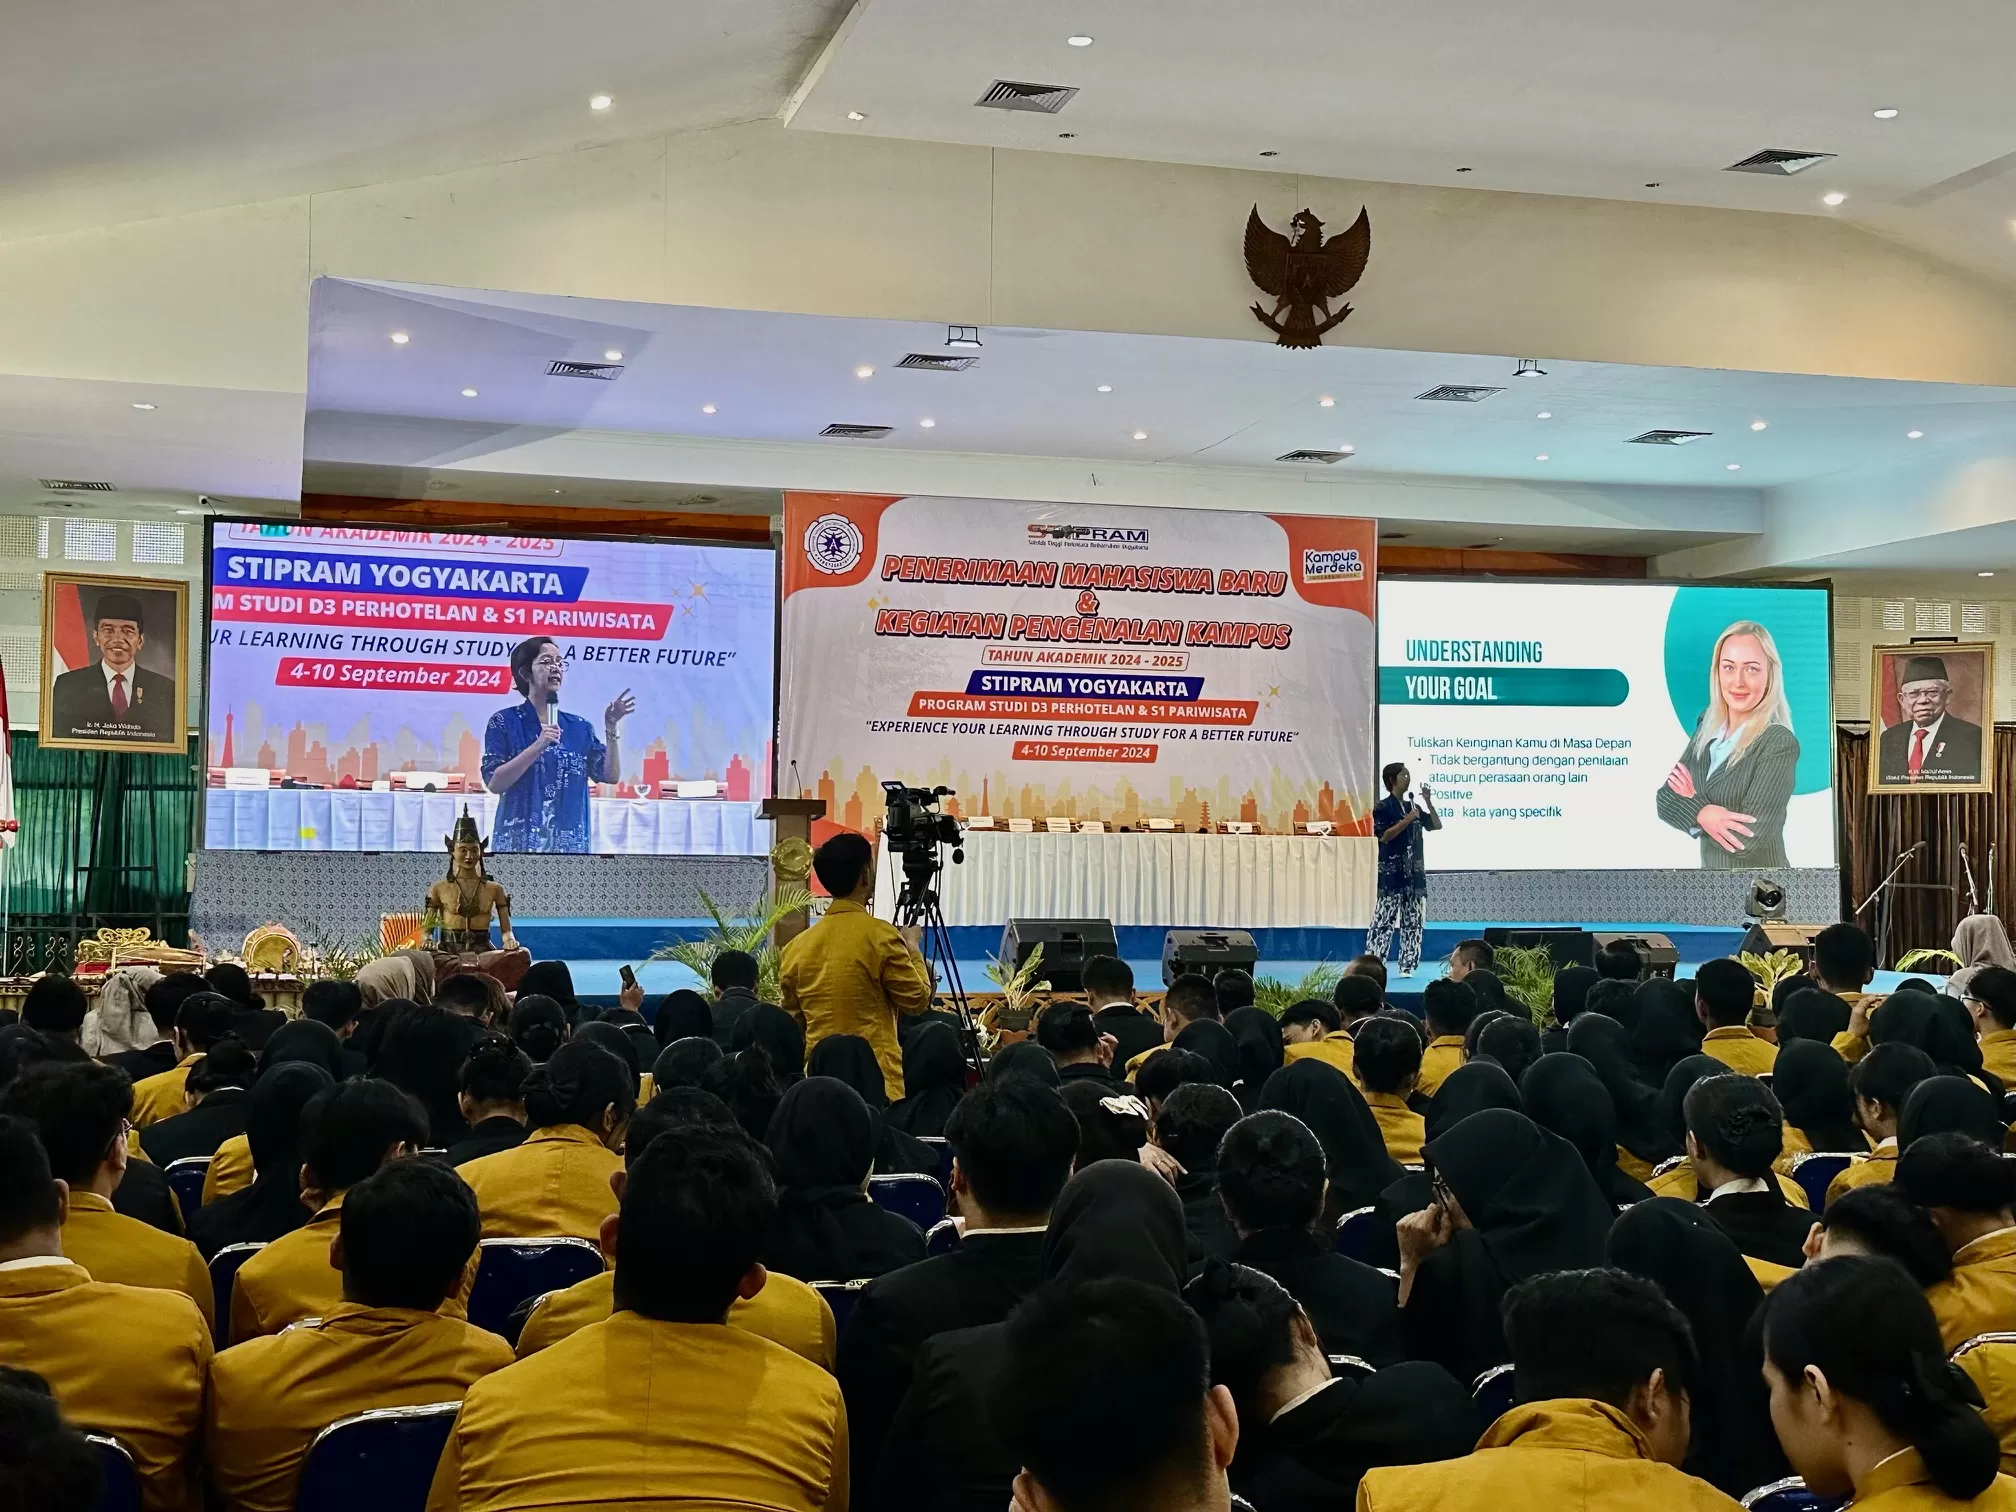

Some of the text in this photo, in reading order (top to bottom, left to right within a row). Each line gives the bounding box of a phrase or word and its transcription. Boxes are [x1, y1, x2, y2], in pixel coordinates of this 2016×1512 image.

[1305, 551, 1357, 564] Kampus
[1305, 561, 1362, 574] Merdeka
[227, 555, 564, 596] STIPRAM YOGYAKARTA
[882, 555, 1057, 587] PENERIMAAN
[1060, 562, 1213, 594] MAHASISWA
[1217, 570, 1288, 597] BARU
[240, 594, 303, 614] STUDI
[309, 598, 337, 616] D3
[342, 600, 477, 623] PERHOTELAN
[482, 606, 499, 622] &
[503, 607, 526, 624] S1
[532, 608, 656, 630] PARIWISATA
[1075, 590, 1100, 616] &
[875, 609, 1292, 650] KEGIATAN PENGENALAN KAMPUS
[238, 629, 344, 651] LEARNING
[350, 634, 449, 655] THROUGH
[453, 639, 516, 658] STUDY
[564, 644, 576, 660] A
[583, 646, 650, 664] BETTER
[1406, 639, 1543, 663] UNDERSTANDING
[988, 650, 1033, 663] TAHUN
[1036, 651, 1107, 665] AKADEMIK
[1109, 653, 1141, 666] 2024
[1152, 655, 1184, 667] 2025
[290, 661, 501, 688] 4-10 September 2024
[981, 675, 1189, 697] STIPRAM YOGYAKARTA
[1405, 675, 1498, 700] YOUR GOAL
[919, 698, 1248, 720] PROGRAM STUDI D3 PERHOTELAN & S1 PARIWISATA
[952, 723, 986, 735] YOUR
[989, 723, 1053, 737] LEARNING
[1057, 725, 1117, 738] THROUGH
[1121, 727, 1160, 739] STUDY
[1162, 728, 1187, 740] FOR
[1189, 730, 1198, 740] A
[1201, 729, 1244, 742] BETTER
[1021, 744, 1150, 760] 4-10 September 2024
[1407, 736, 1632, 752] Tuliskan Keinginan Kamu di Masa Depan
[1429, 754, 1629, 768] Tidak bergantung dengan penilaian
[1429, 772, 1588, 785] ataupun perasaan orang lain
[1438, 806, 1454, 817] ata
[1463, 805, 1487, 817] kata
[1489, 806, 1517, 819] yang
[1519, 806, 1562, 819] specifik
